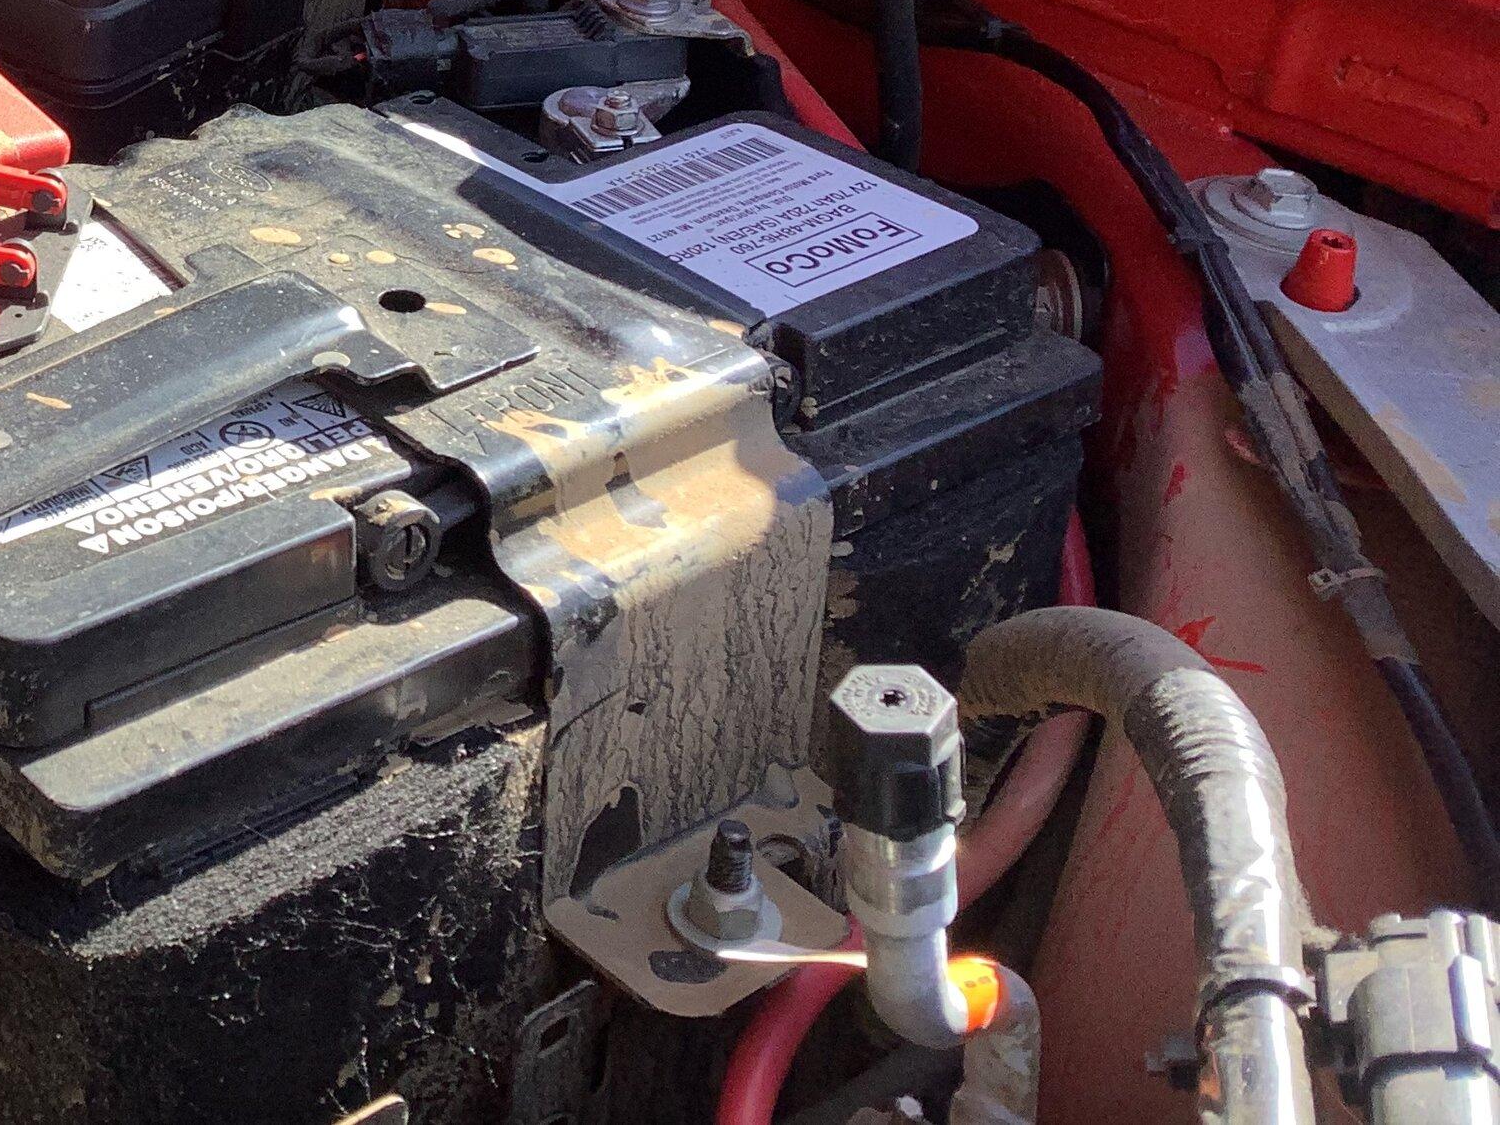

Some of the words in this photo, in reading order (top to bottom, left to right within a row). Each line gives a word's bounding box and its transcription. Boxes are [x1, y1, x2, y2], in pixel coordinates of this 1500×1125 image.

[809, 189, 852, 207] 70Ah
[846, 179, 877, 192] 12V
[709, 215, 781, 245] (SAE/EN)
[727, 202, 857, 256] BAGM-48H6-760
[774, 203, 816, 220] 720A
[760, 219, 906, 276] FoMoCo
[463, 363, 601, 433] FRONT
[177, 440, 210, 455] ACID
[88, 417, 374, 526] PELIGRO/VENENO
[102, 442, 374, 545] DANGER/POISON
